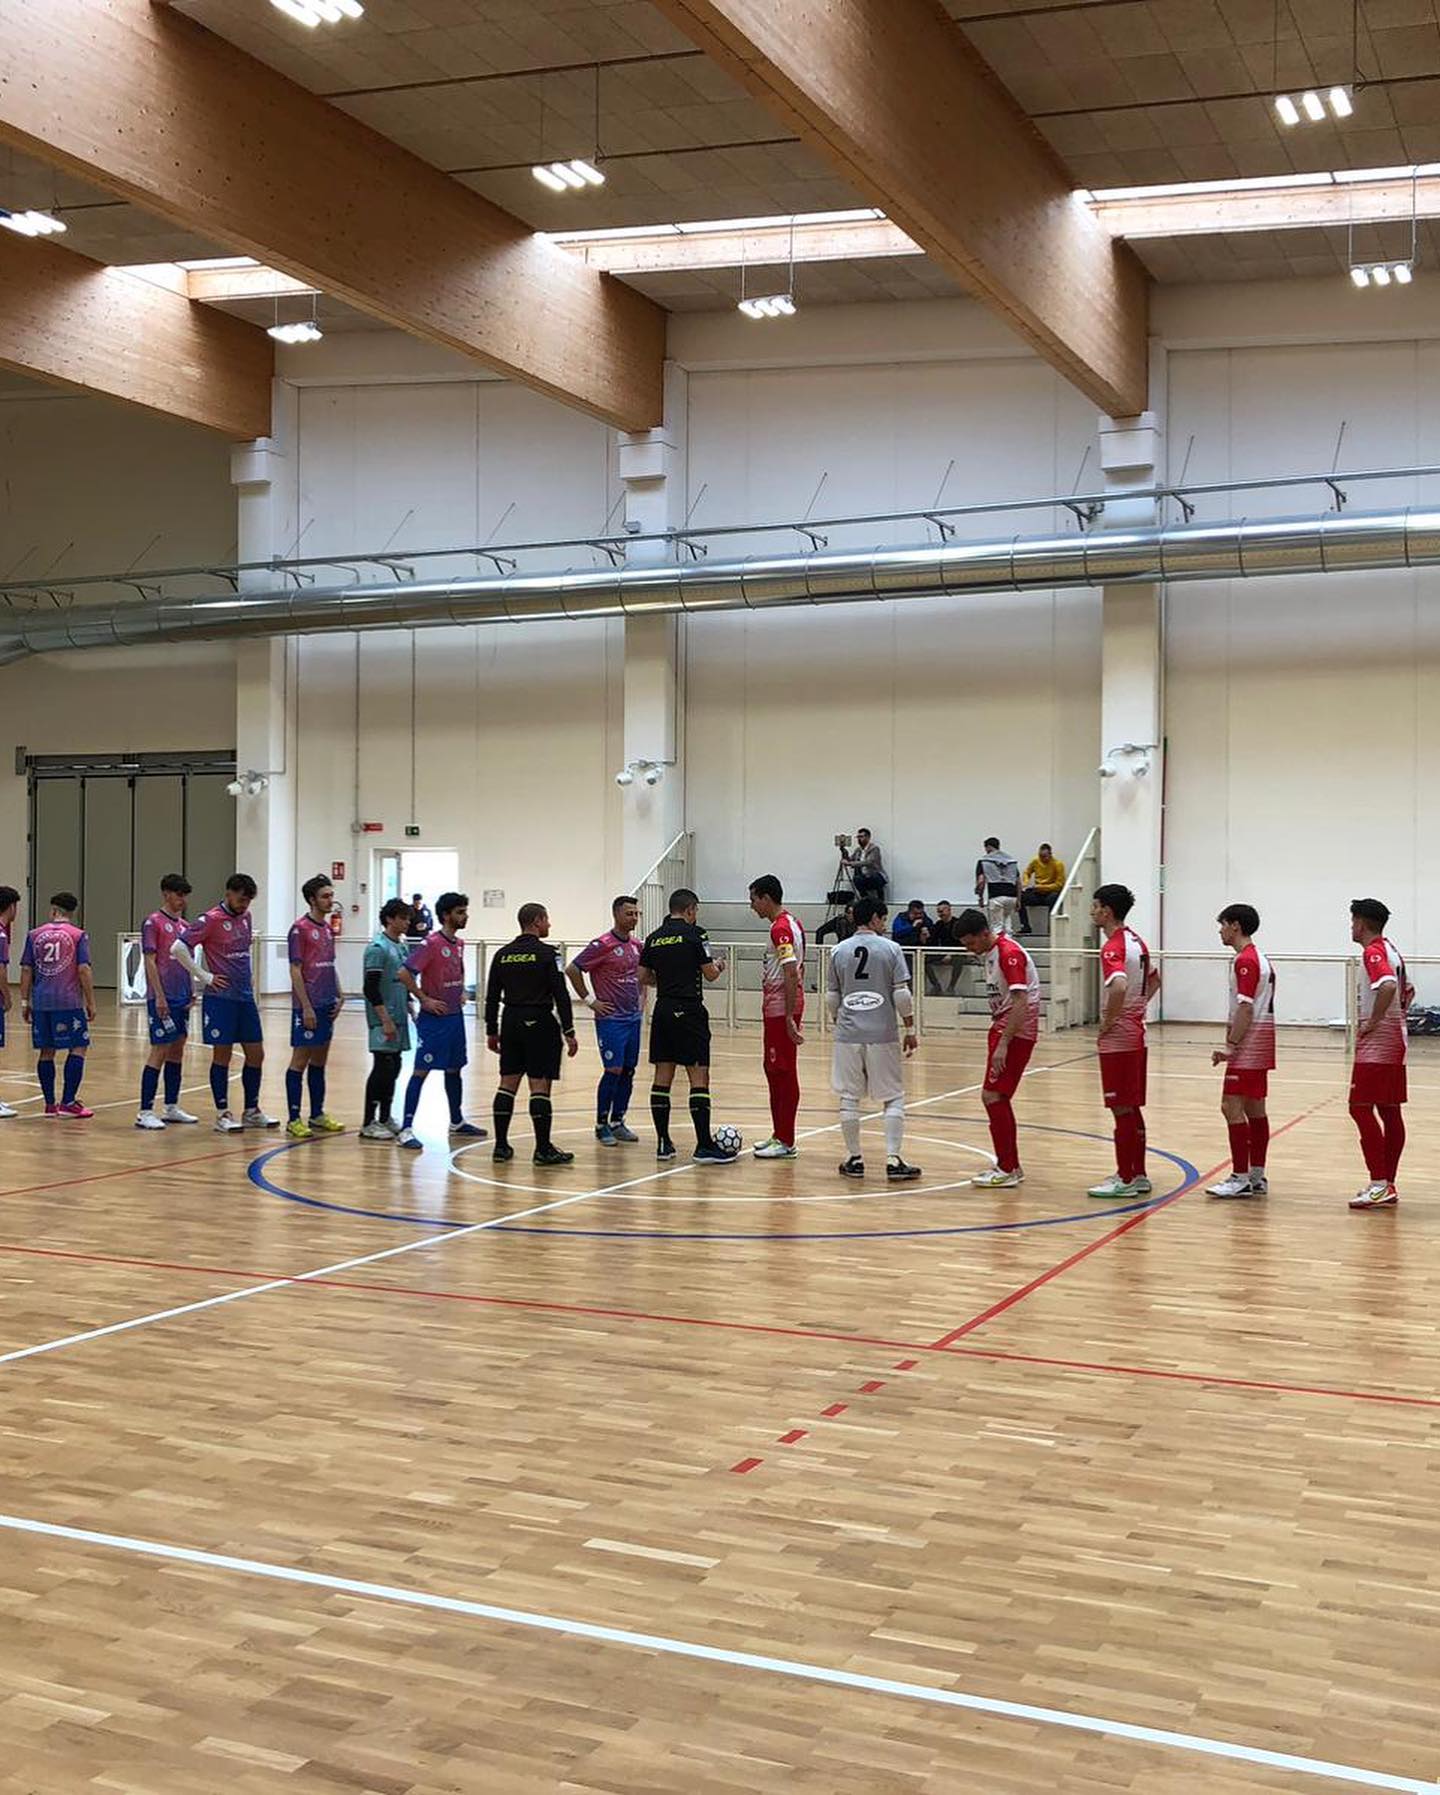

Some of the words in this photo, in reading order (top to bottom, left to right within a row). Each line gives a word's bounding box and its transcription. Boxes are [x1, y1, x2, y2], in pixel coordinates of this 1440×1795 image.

[650, 935, 683, 948] LEGEA
[44, 941, 61, 962] 21
[500, 953, 536, 964] LEGEA
[854, 946, 869, 980] 2
